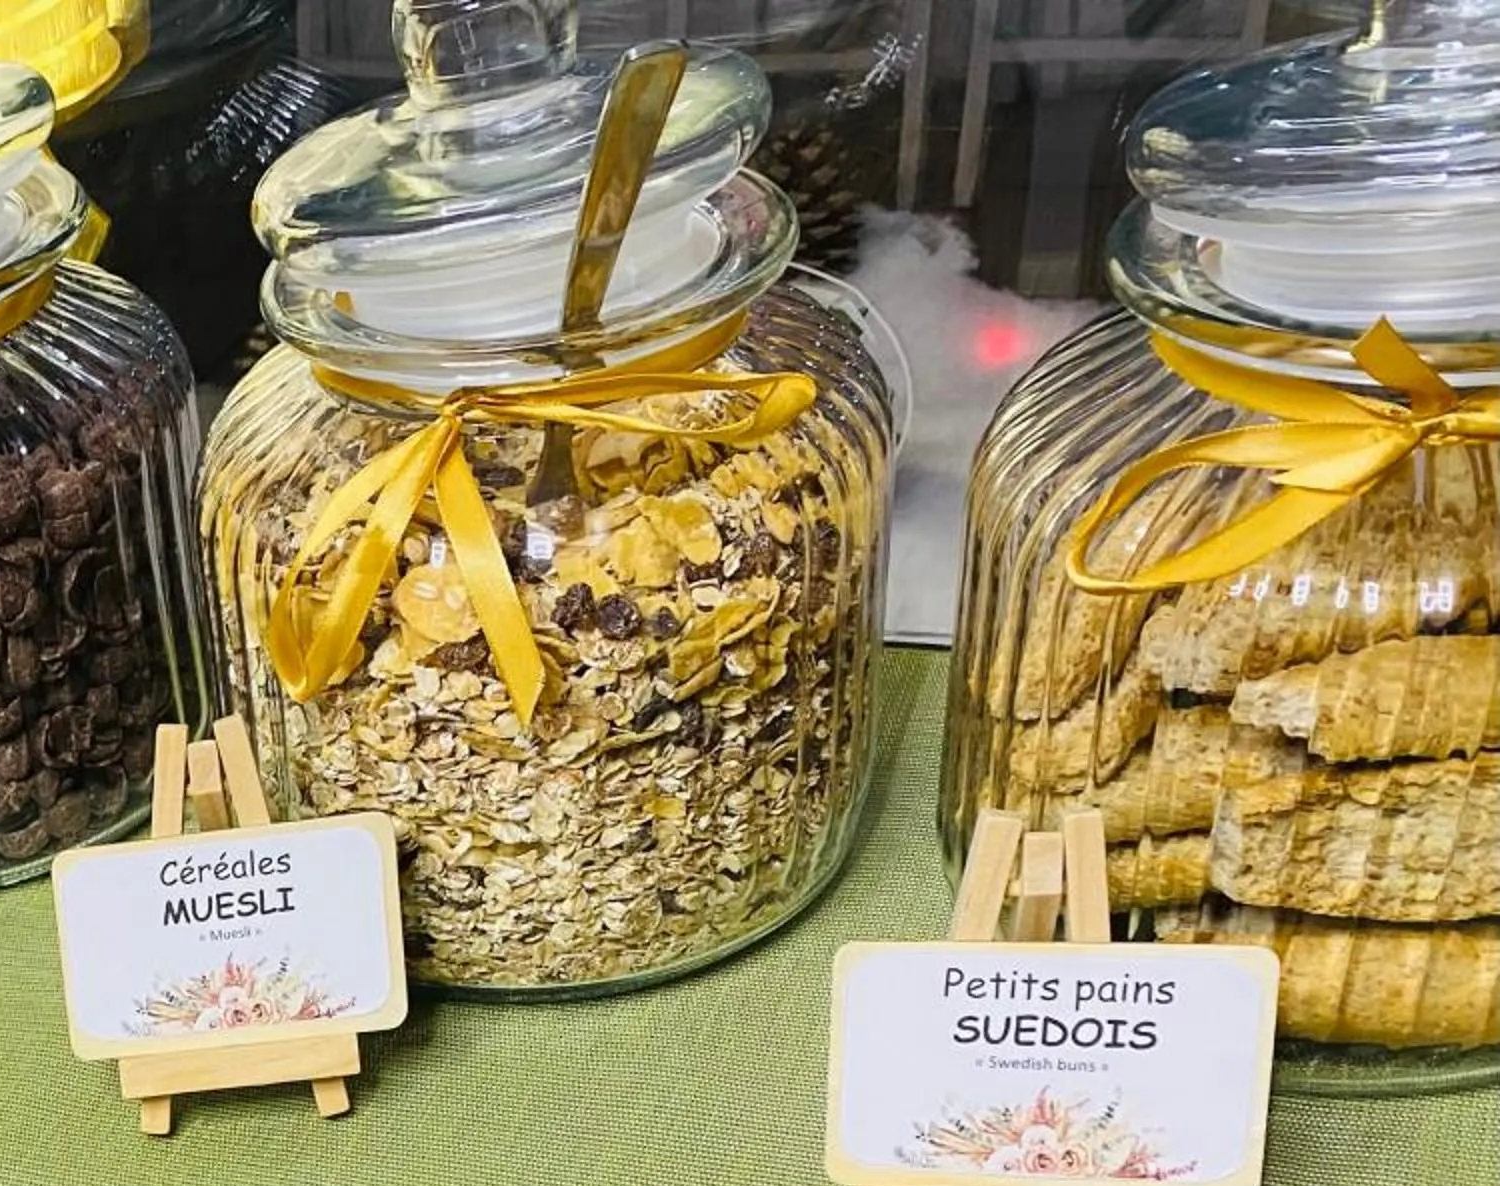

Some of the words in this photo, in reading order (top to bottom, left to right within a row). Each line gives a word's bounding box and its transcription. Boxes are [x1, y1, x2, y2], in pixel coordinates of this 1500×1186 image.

[159, 849, 292, 887] Céréales
[163, 887, 296, 926] MUESLI
[210, 926, 251, 941] Muesli
[943, 966, 1060, 1002] Petits
[1075, 973, 1176, 1011] pains
[953, 1014, 1158, 1050] SUEDOIS
[988, 1055, 1053, 1071] Swedish
[1057, 1058, 1097, 1073] buns
